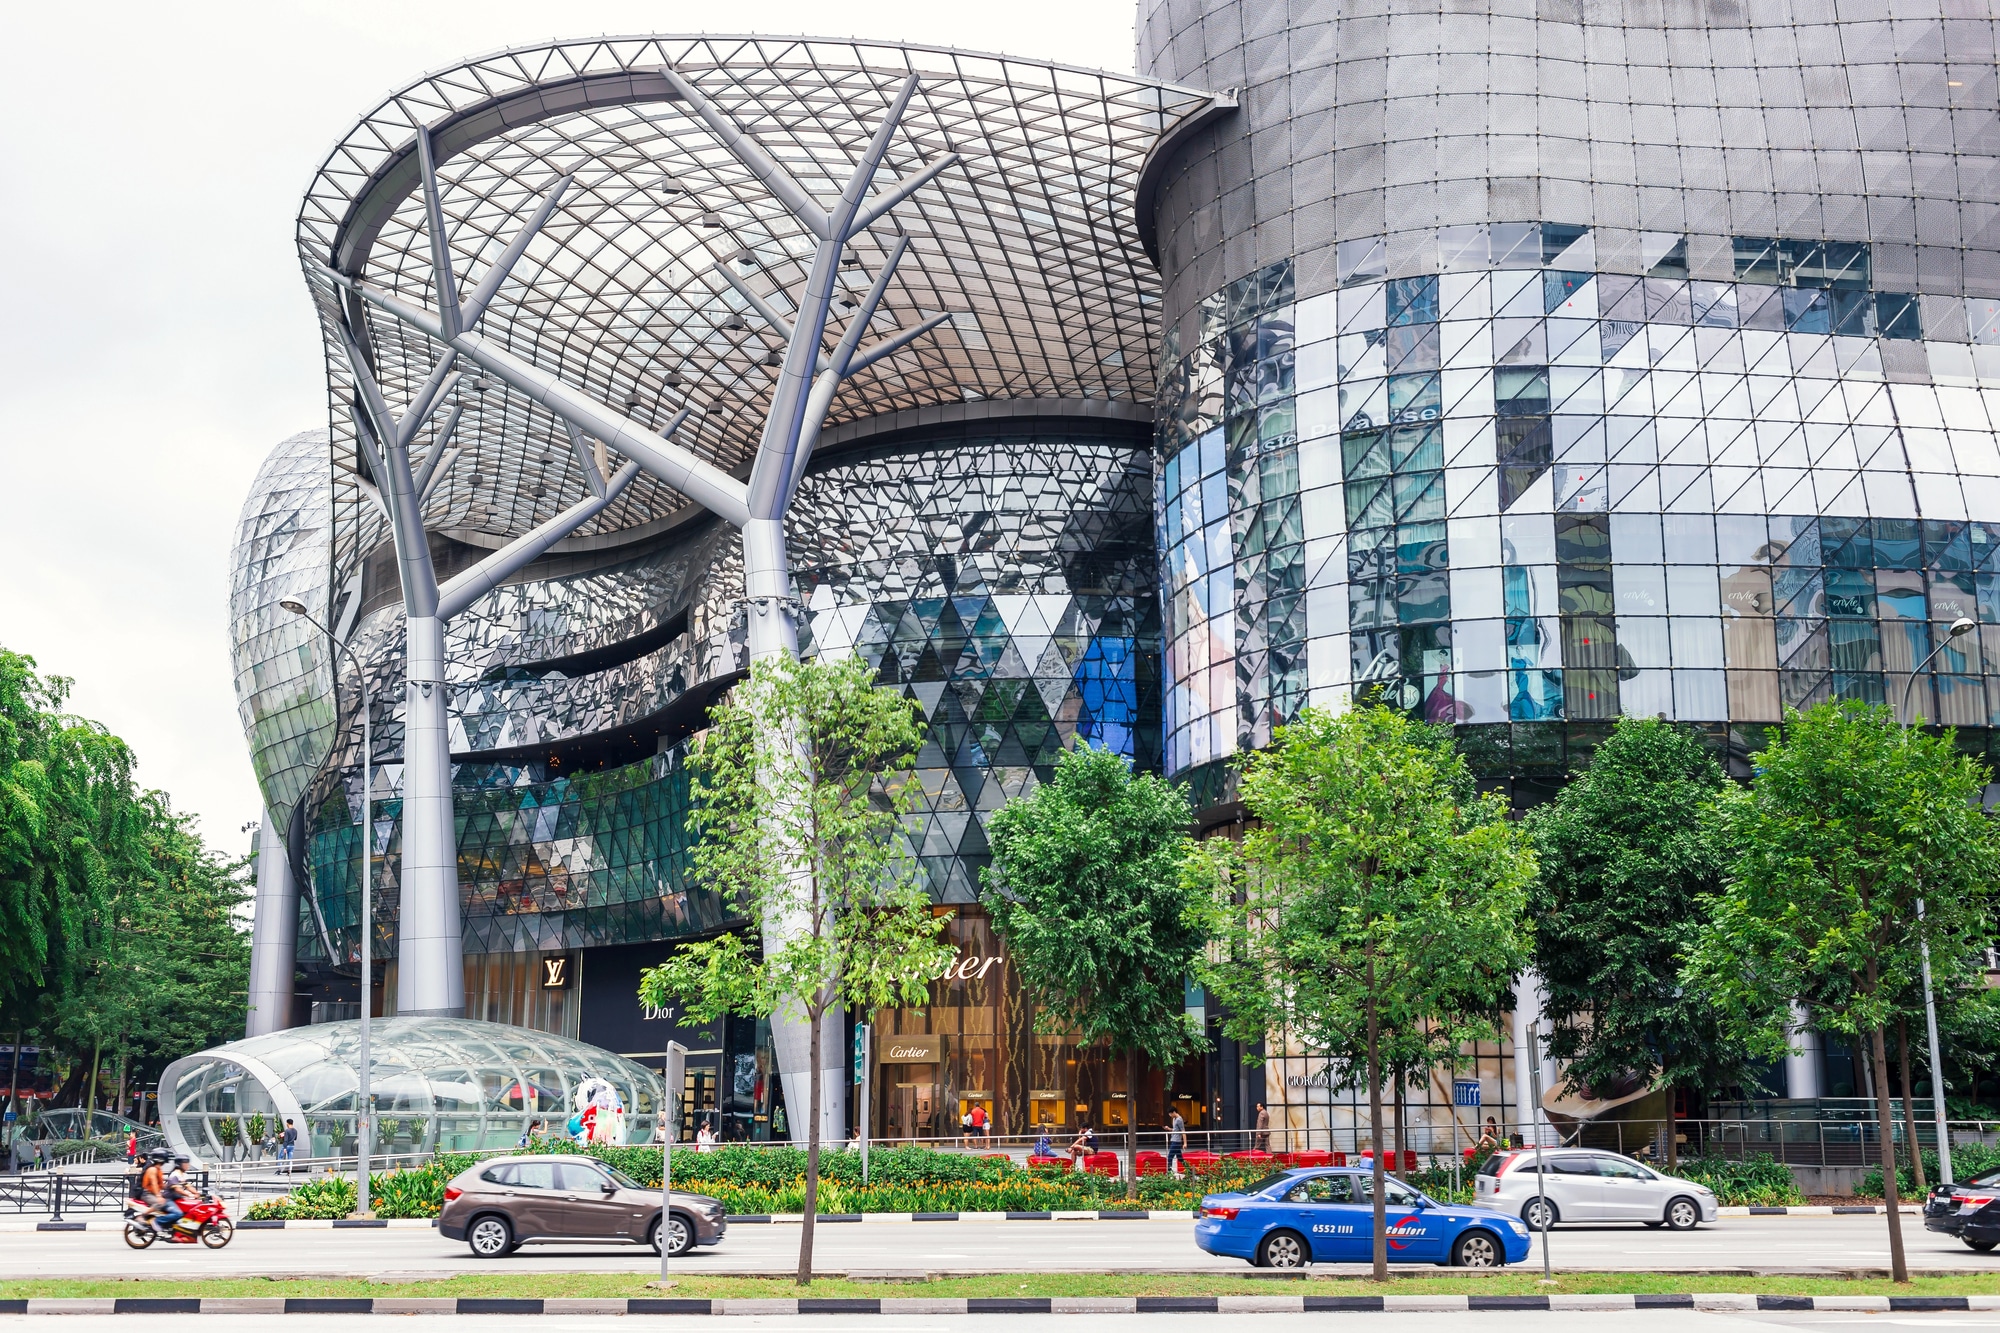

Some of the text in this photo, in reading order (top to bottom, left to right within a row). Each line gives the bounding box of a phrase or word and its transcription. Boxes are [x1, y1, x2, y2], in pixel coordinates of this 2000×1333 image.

[643, 1000, 674, 1020] Dior
[890, 1045, 929, 1058] Cartier
[1286, 1076, 1329, 1087] GIORGIO
[1312, 1224, 1353, 1234] 6552 1111
[1385, 1225, 1427, 1236] Comfort
